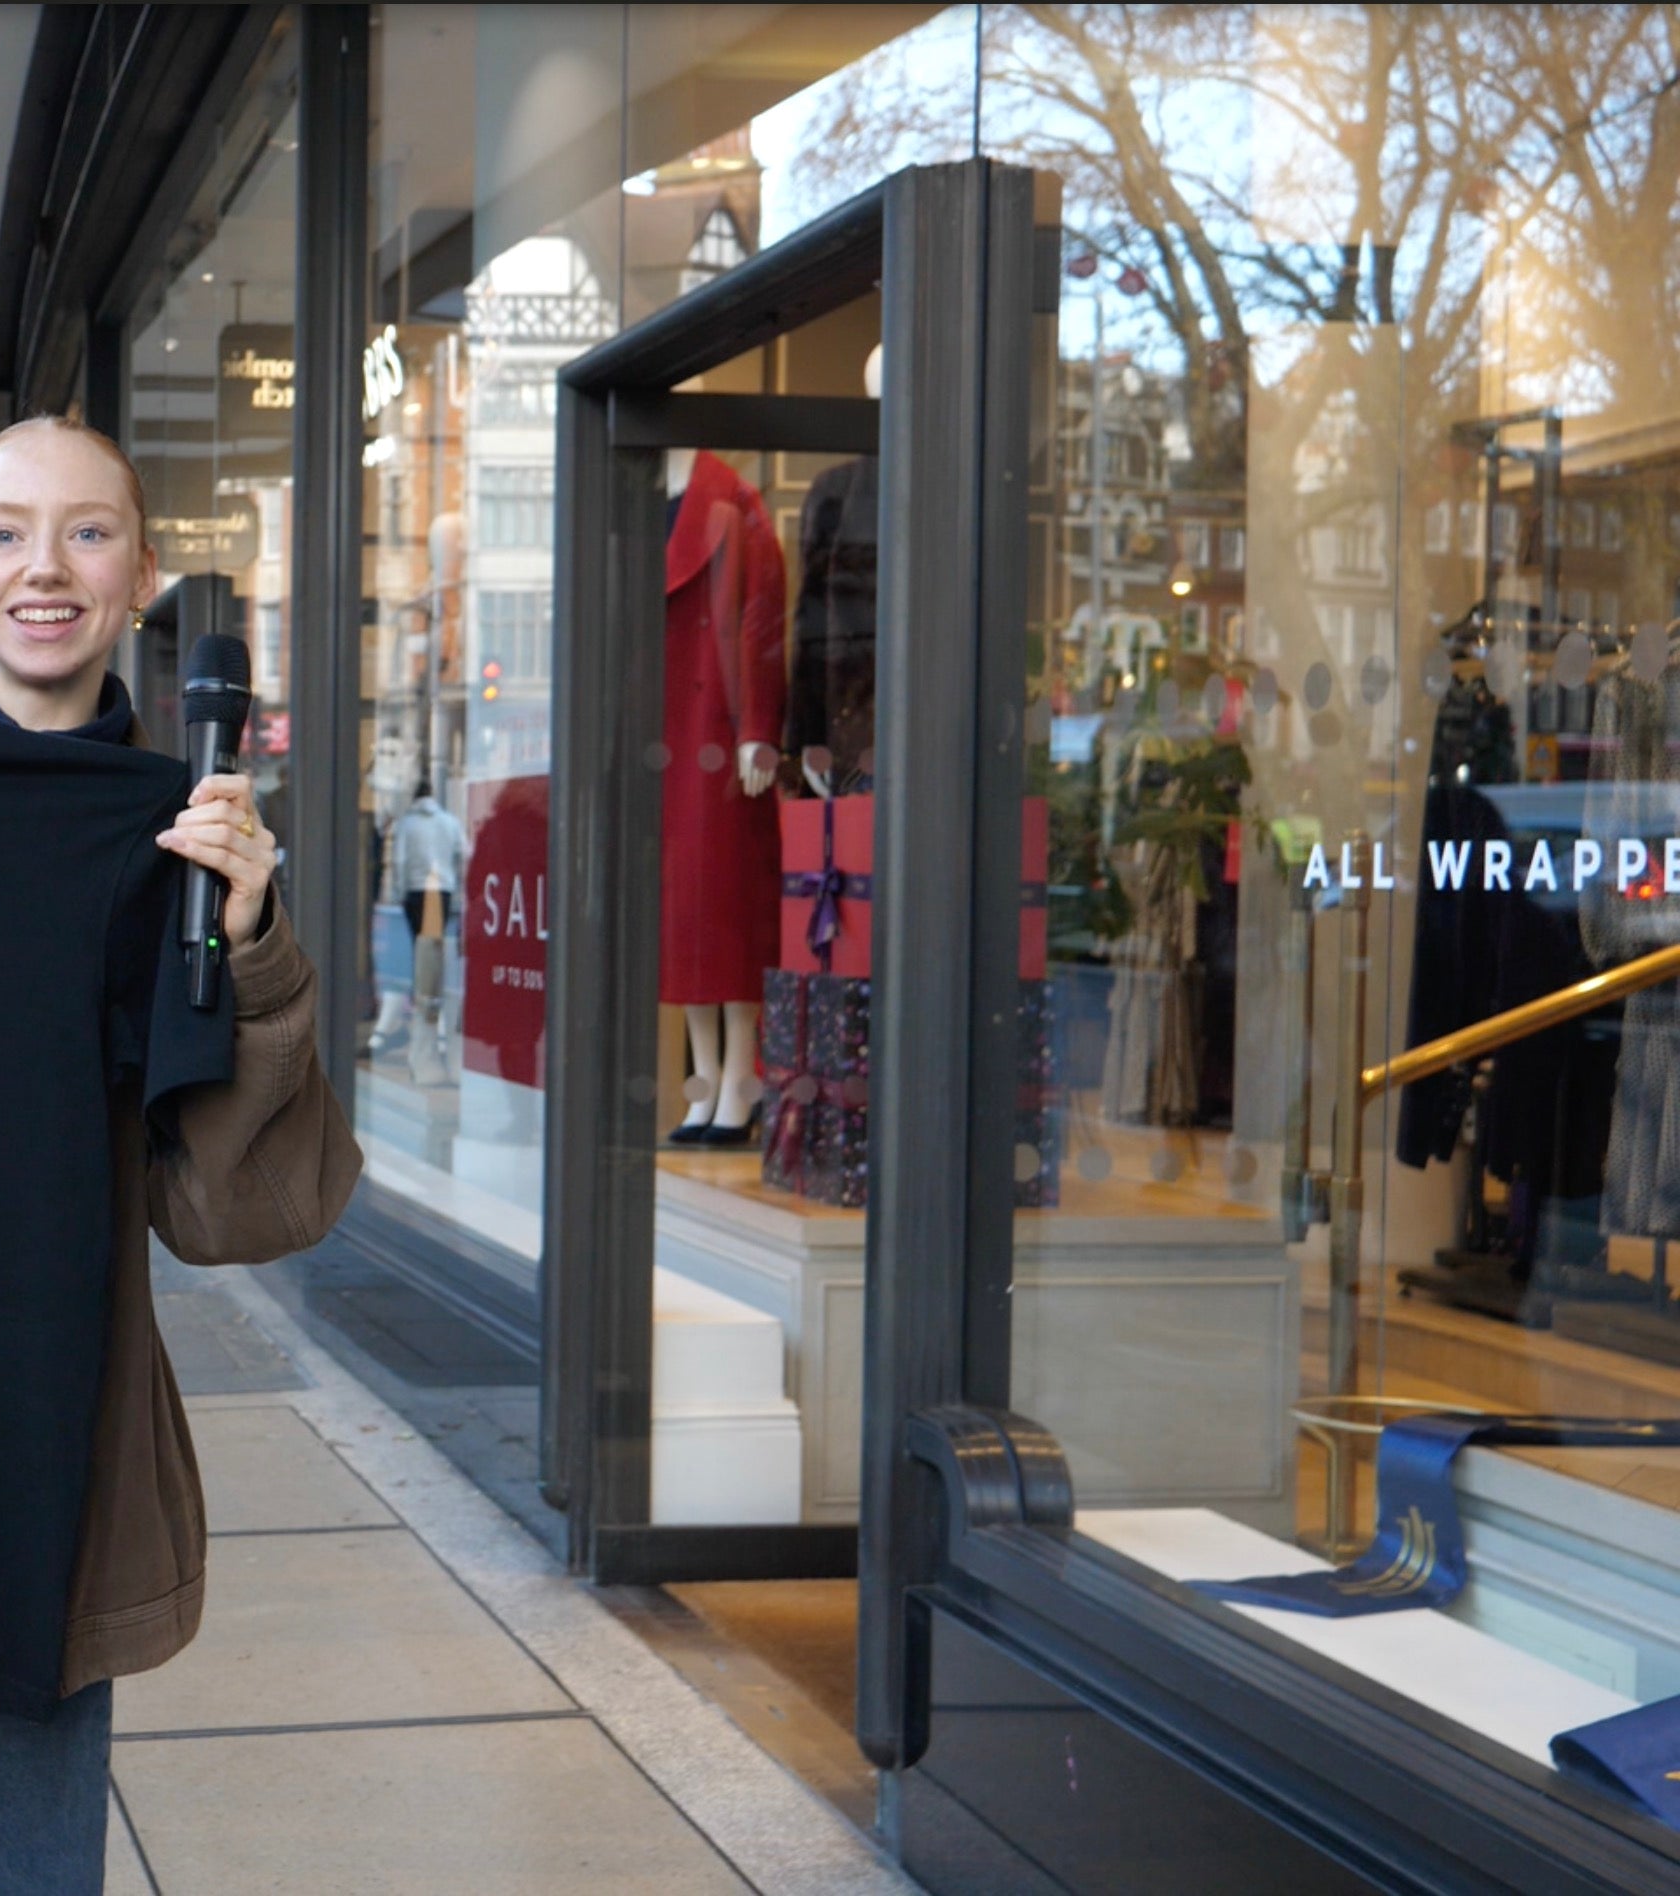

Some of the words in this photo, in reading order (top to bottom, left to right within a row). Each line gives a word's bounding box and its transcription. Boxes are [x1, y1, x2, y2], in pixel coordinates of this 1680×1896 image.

[1303, 841, 1394, 889] ALL
[1428, 838, 1680, 893] WRAPPE
[483, 873, 549, 940] SAL
[492, 964, 506, 985] UP
[507, 966, 521, 988] TO
